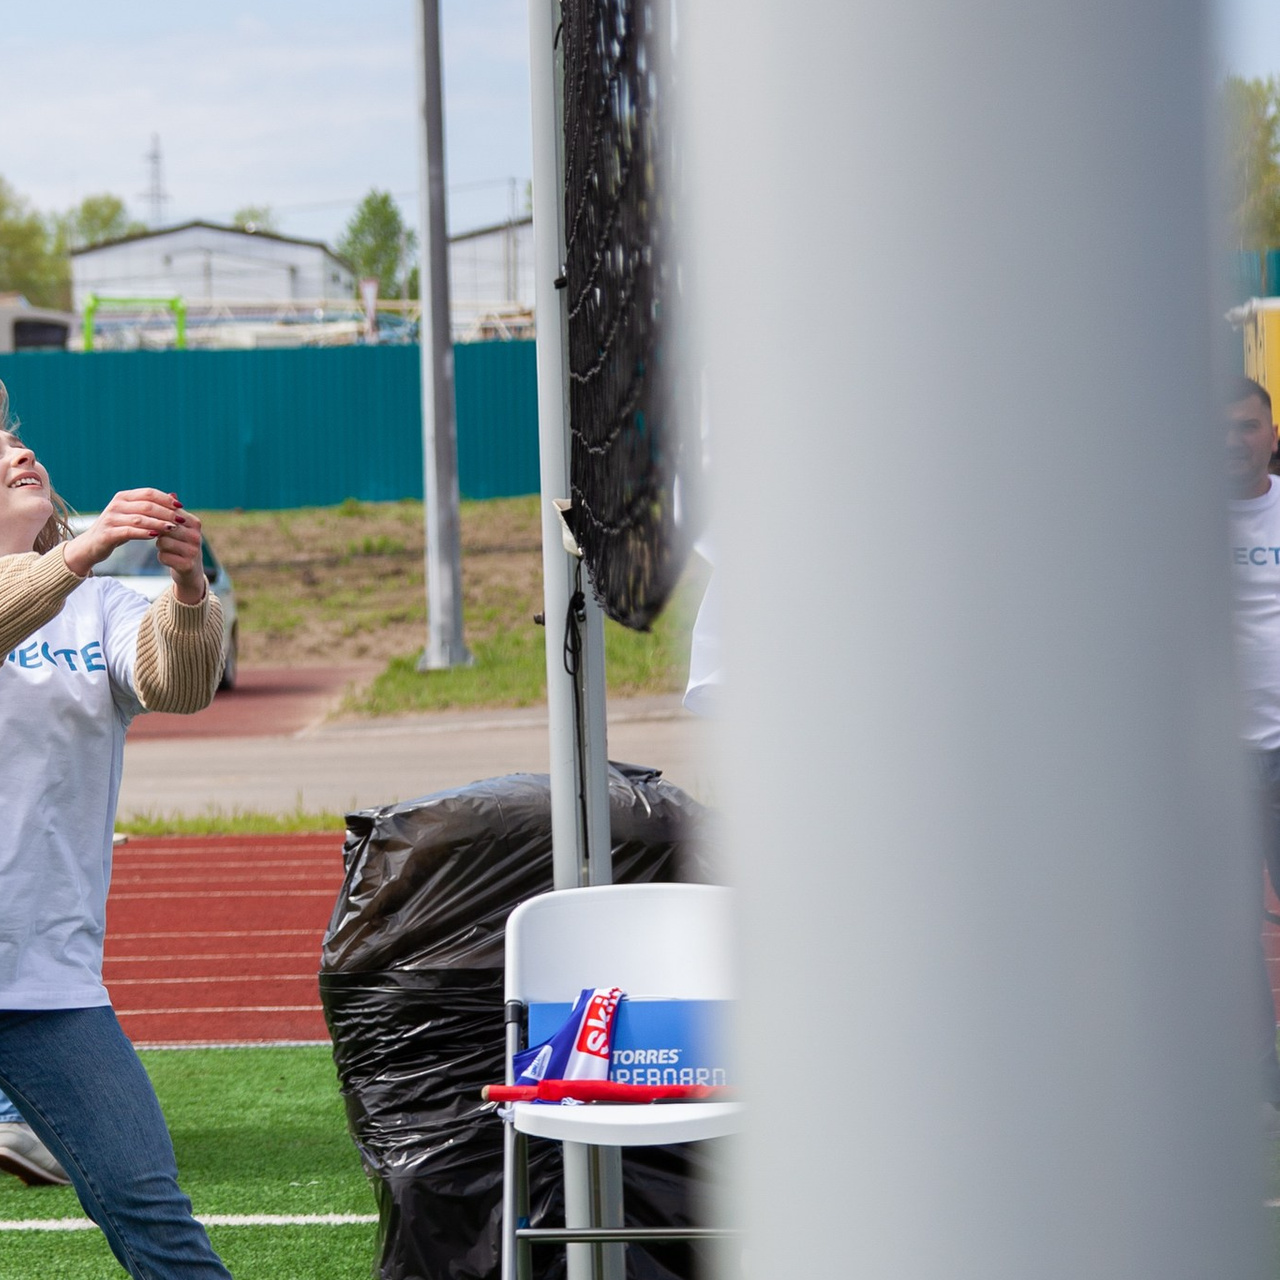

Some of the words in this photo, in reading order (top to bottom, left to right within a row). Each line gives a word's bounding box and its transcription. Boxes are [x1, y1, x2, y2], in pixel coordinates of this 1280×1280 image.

[1232, 546, 1280, 566] ЕСТ
[8, 640, 107, 673] ЕСТЕ
[613, 1048, 680, 1065] TORRES
[609, 1067, 727, 1086] REBOARD
